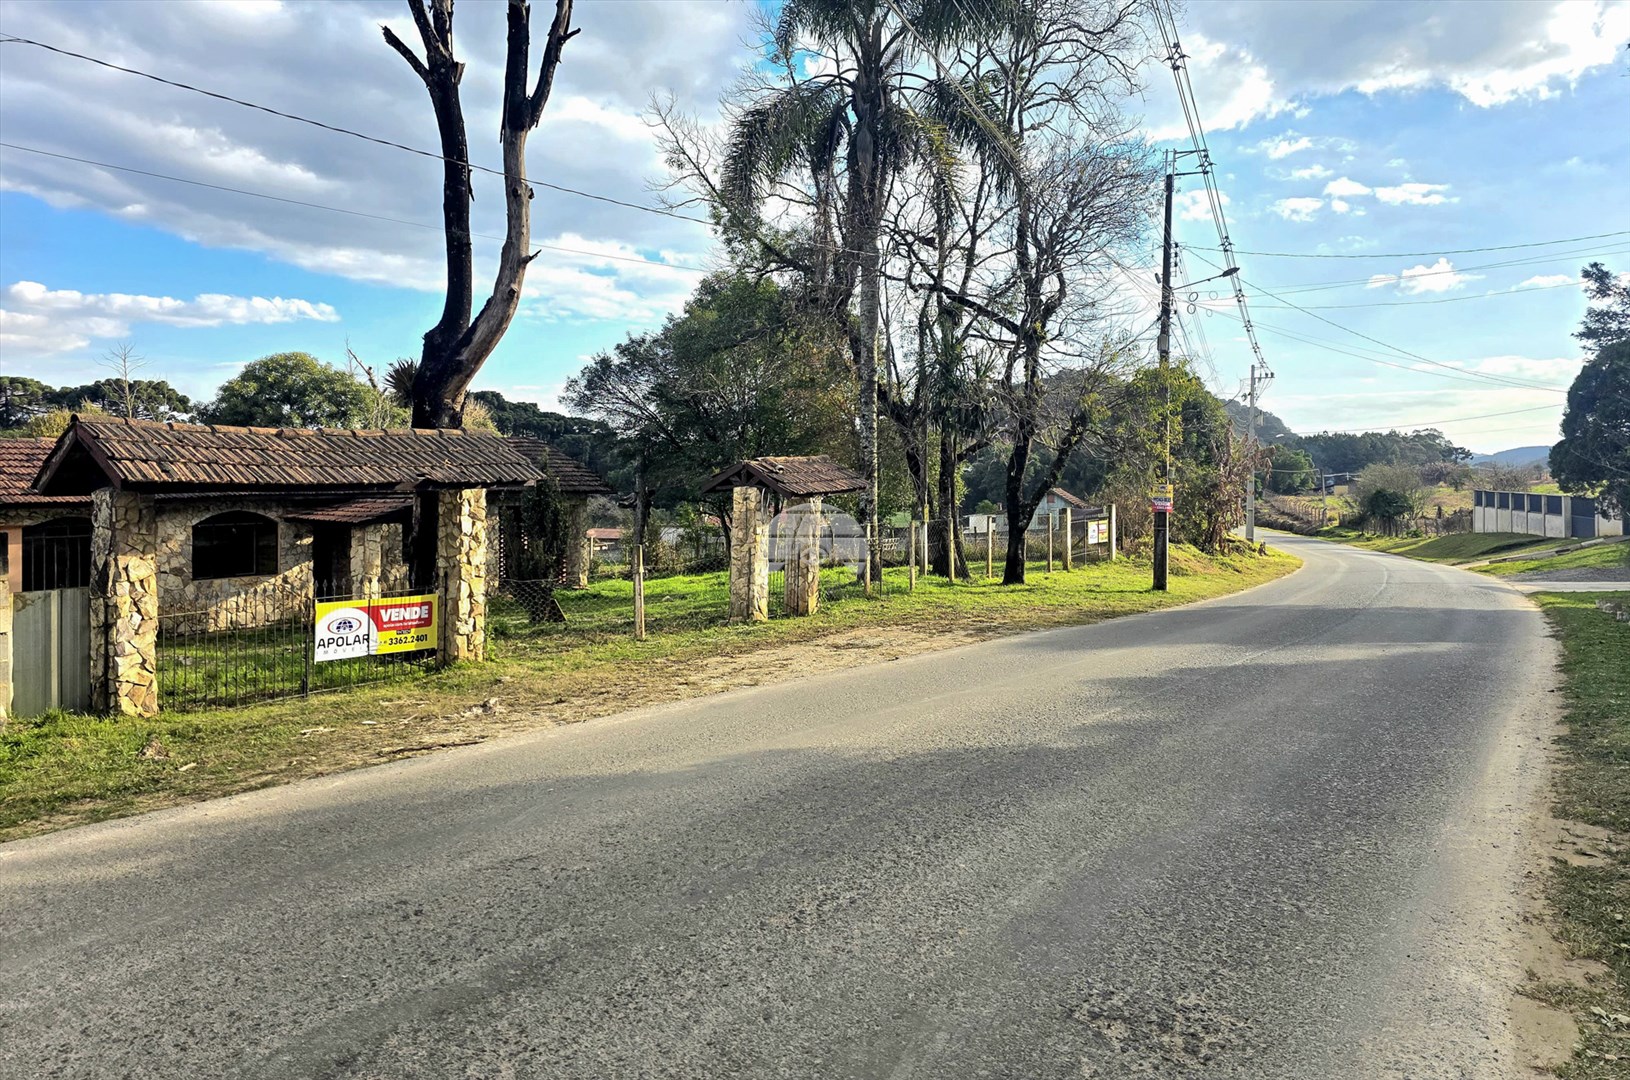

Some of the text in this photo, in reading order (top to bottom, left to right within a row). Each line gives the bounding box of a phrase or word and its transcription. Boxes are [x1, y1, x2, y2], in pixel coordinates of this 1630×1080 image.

[380, 606, 428, 622] VENDE
[317, 634, 369, 649] APOLAR
[389, 634, 427, 645] 3362.2401
